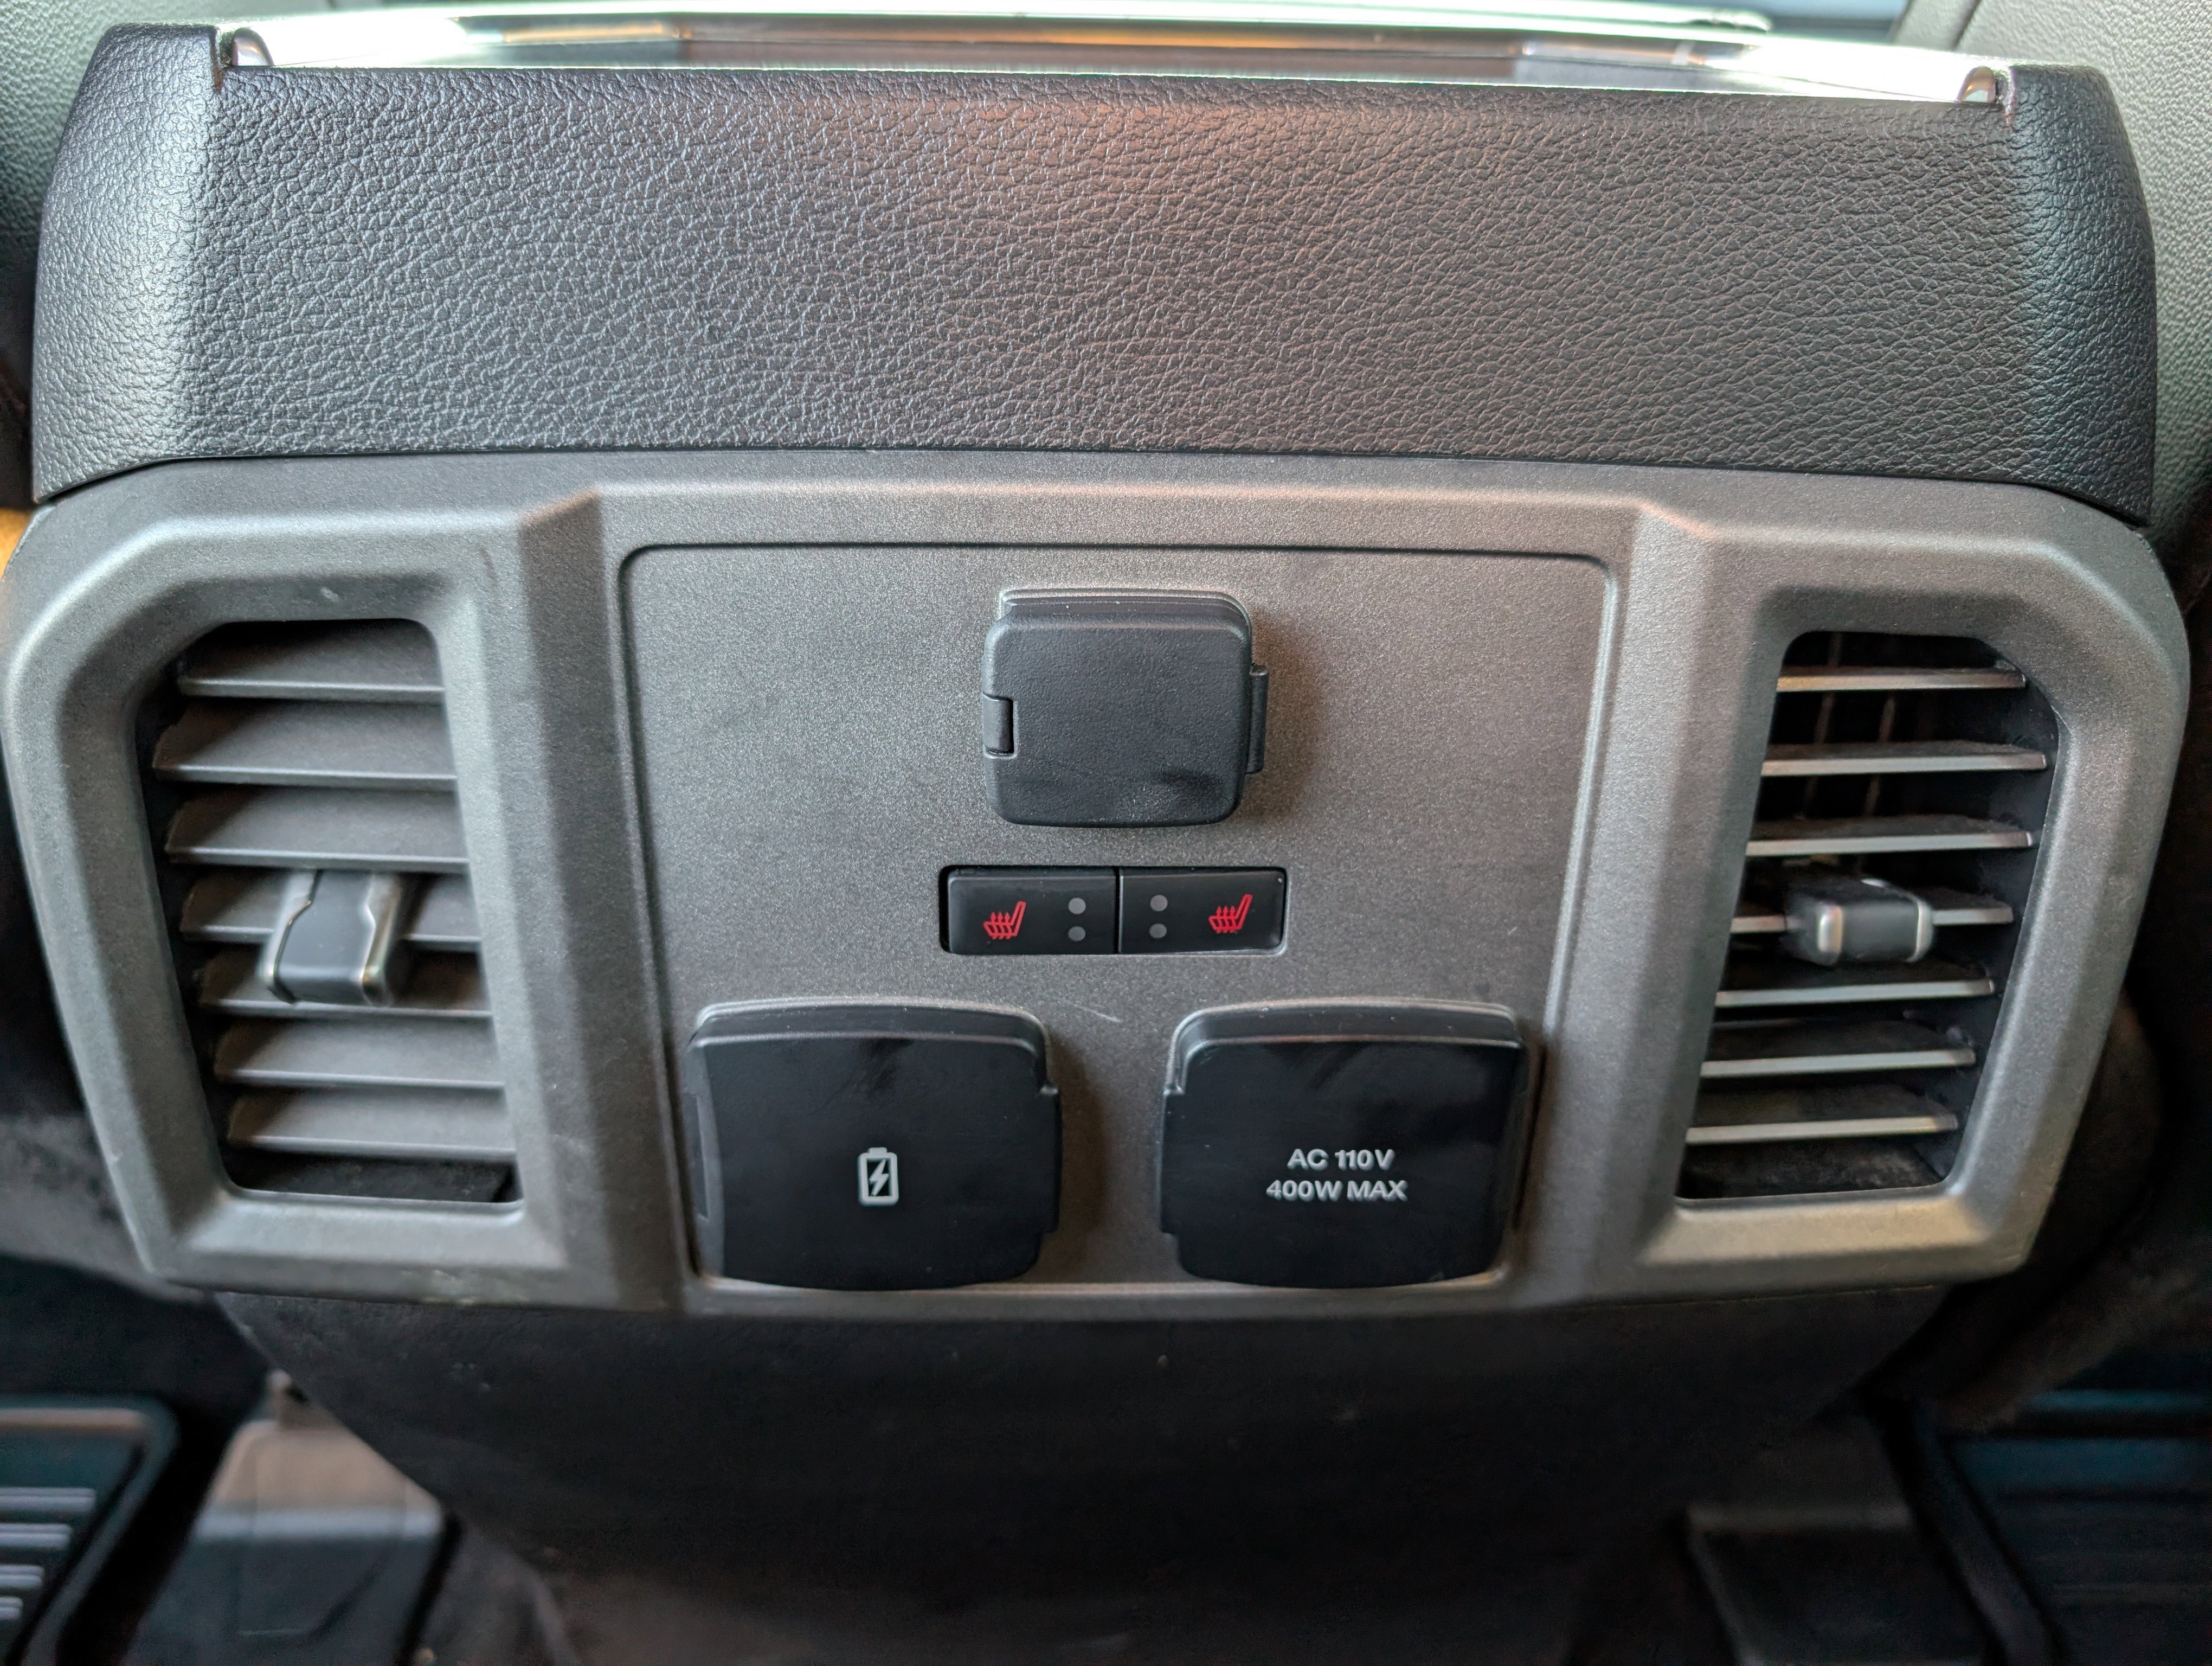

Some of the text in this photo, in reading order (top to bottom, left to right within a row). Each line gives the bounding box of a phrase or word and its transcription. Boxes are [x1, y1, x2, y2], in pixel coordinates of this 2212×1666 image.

[1287, 1148, 1396, 1171] AC 110V
[1266, 1180, 1409, 1202] 400W MAX
